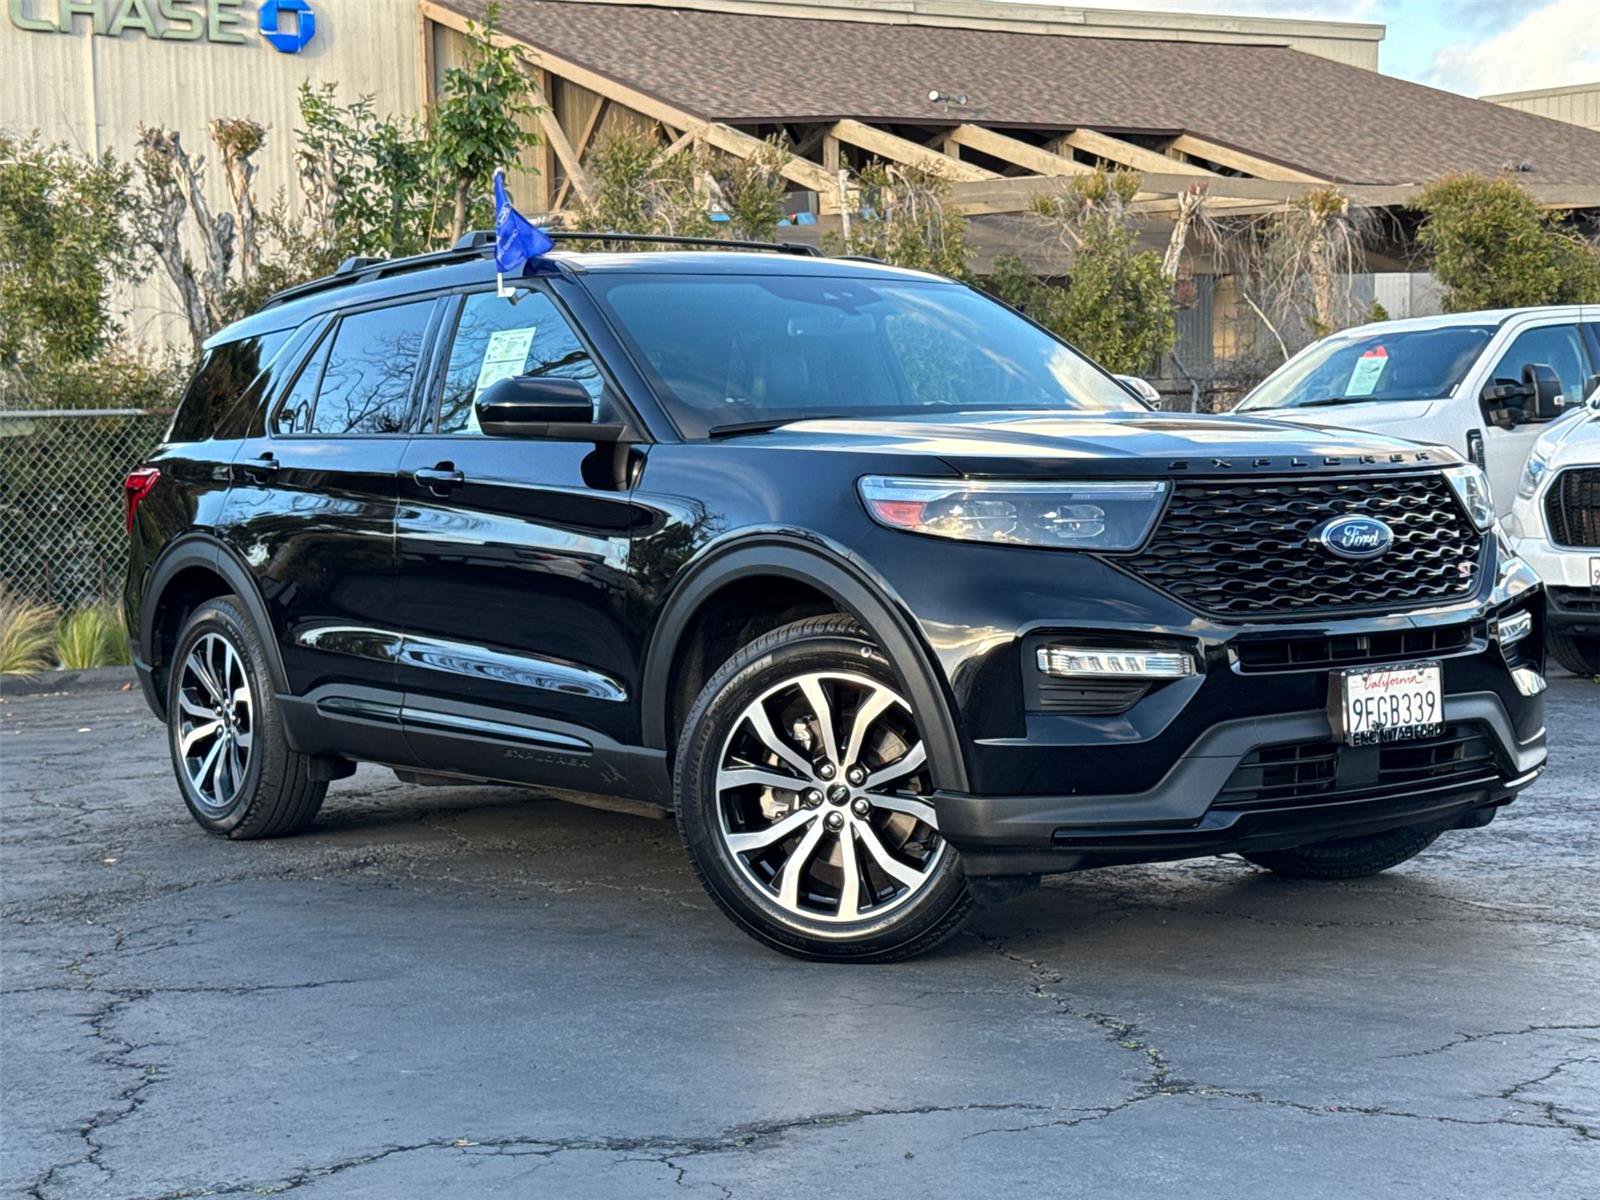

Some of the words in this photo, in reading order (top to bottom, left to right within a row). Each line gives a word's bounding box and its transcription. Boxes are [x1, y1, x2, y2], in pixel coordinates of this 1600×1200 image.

[8, 0, 248, 45] CHASE
[1342, 525, 1379, 548] Ford
[1364, 670, 1423, 693] California
[1352, 691, 1435, 732] 9FGB339
